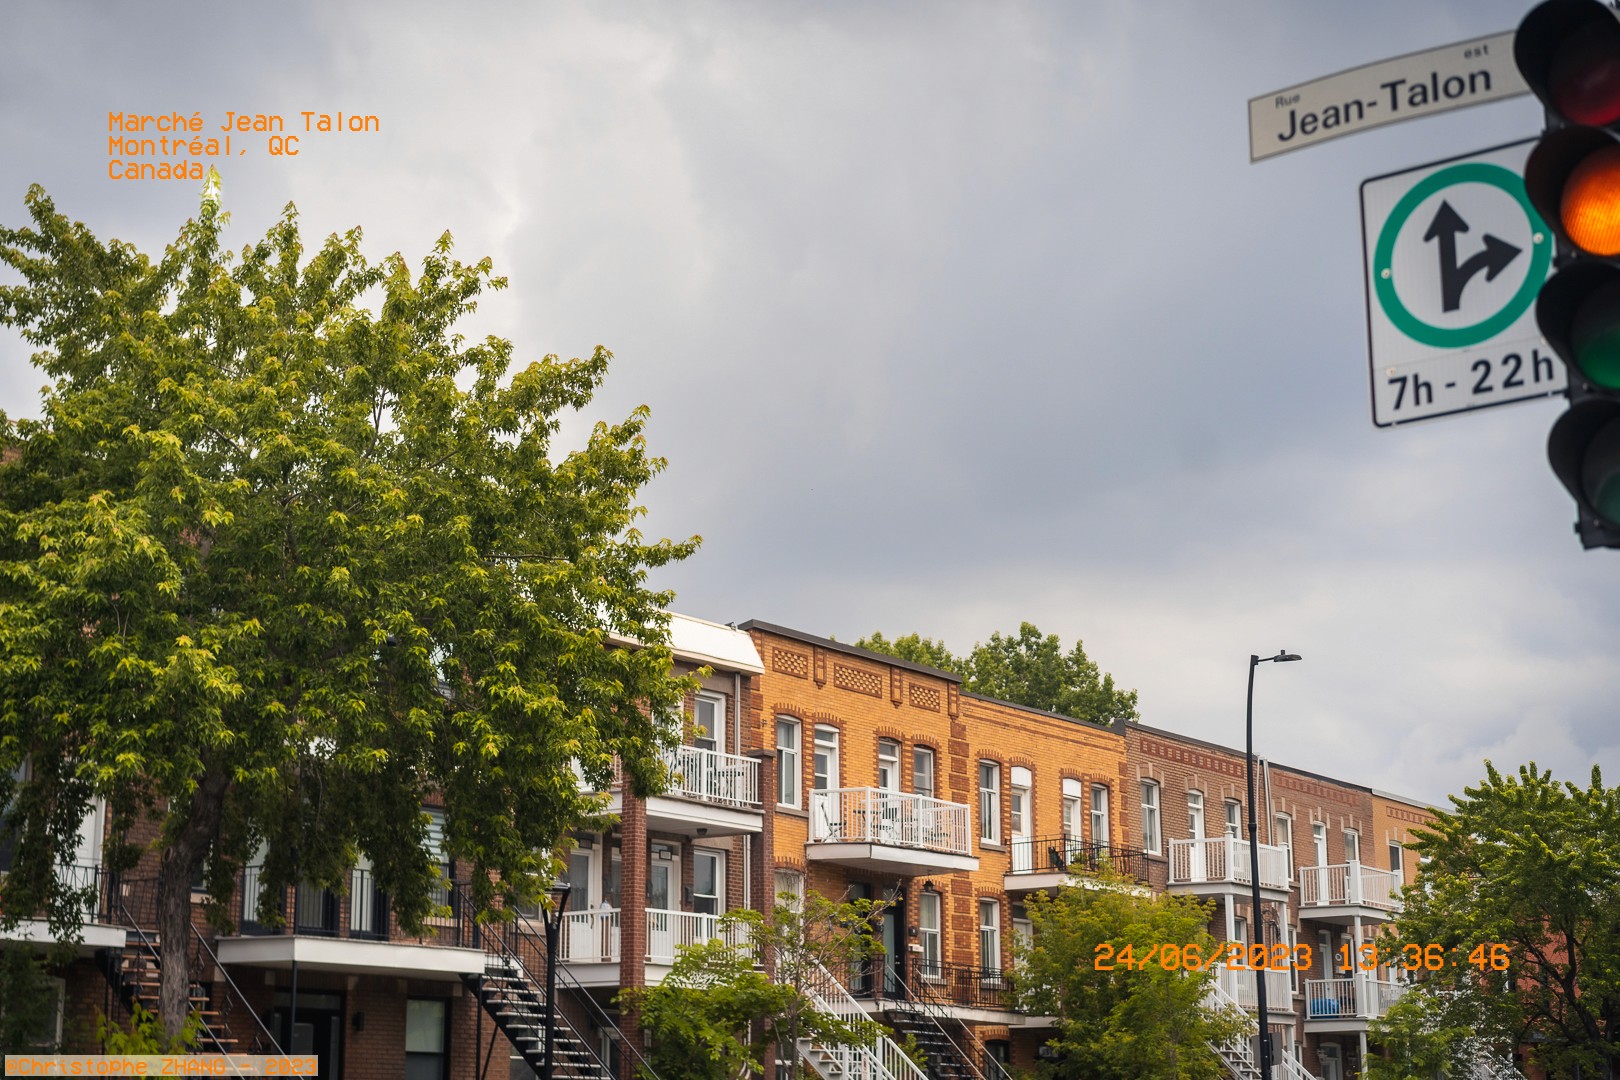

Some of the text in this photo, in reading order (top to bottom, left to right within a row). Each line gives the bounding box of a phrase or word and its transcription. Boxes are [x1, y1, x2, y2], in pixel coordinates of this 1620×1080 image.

[1463, 43, 1489, 60] est
[1274, 94, 1301, 109] Rue
[1277, 69, 1492, 142] Jean-Talon
[1388, 373, 1433, 411] 7h
[1470, 348, 1554, 395] 22h
